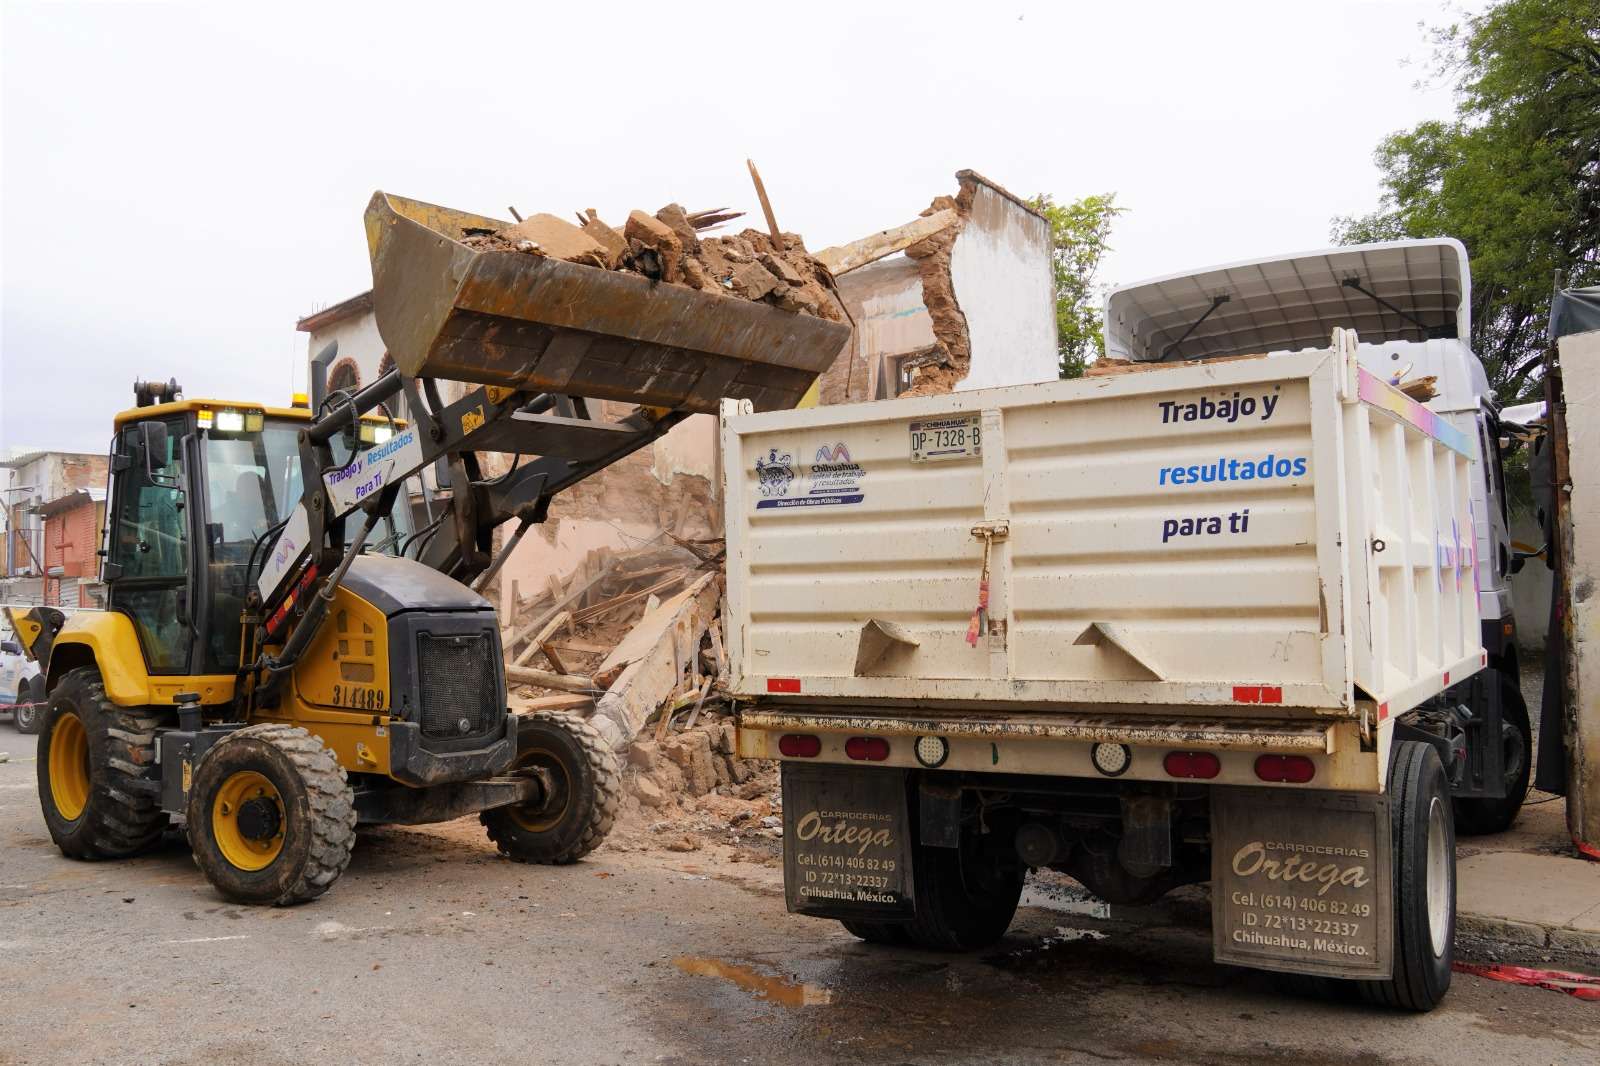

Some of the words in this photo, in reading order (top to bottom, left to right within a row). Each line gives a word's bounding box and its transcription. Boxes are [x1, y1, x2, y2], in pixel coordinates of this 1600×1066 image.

[1158, 391, 1256, 424] Trabajo
[1261, 394, 1279, 421] y
[926, 419, 966, 428] CHIHUAHUA
[912, 426, 981, 451] DP-7328-B
[329, 464, 357, 486] Trabajo
[357, 460, 363, 474] y
[367, 432, 413, 466] Resultados
[811, 463, 861, 472] Chihuahua
[1159, 454, 1307, 486] resultados
[355, 481, 374, 500] Para
[374, 471, 382, 487] Ti
[1162, 516, 1222, 543] para
[1228, 508, 1249, 534] ti
[820, 810, 894, 822] CARROCERIAS
[796, 810, 894, 855] Ortega
[797, 853, 817, 866] Cel.
[818, 855, 844, 868] (614)
[846, 857, 865, 869] 406
[867, 859, 880, 870] 82
[882, 860, 896, 872] 49
[1265, 841, 1370, 858] CARROCERIAS
[805, 871, 817, 882] ID
[1231, 841, 1371, 897] Ortega
[800, 886, 855, 901] Chihuahua,
[856, 890, 897, 903] México.
[1231, 891, 1258, 906] Cel.
[1260, 893, 1297, 910] (614)
[1299, 896, 1328, 913] 406
[1330, 900, 1349, 915] 82
[1351, 903, 1371, 918] 49
[1242, 912, 1258, 926] ID
[1232, 929, 1311, 951] Chihuahua,
[1313, 938, 1370, 956] México.
